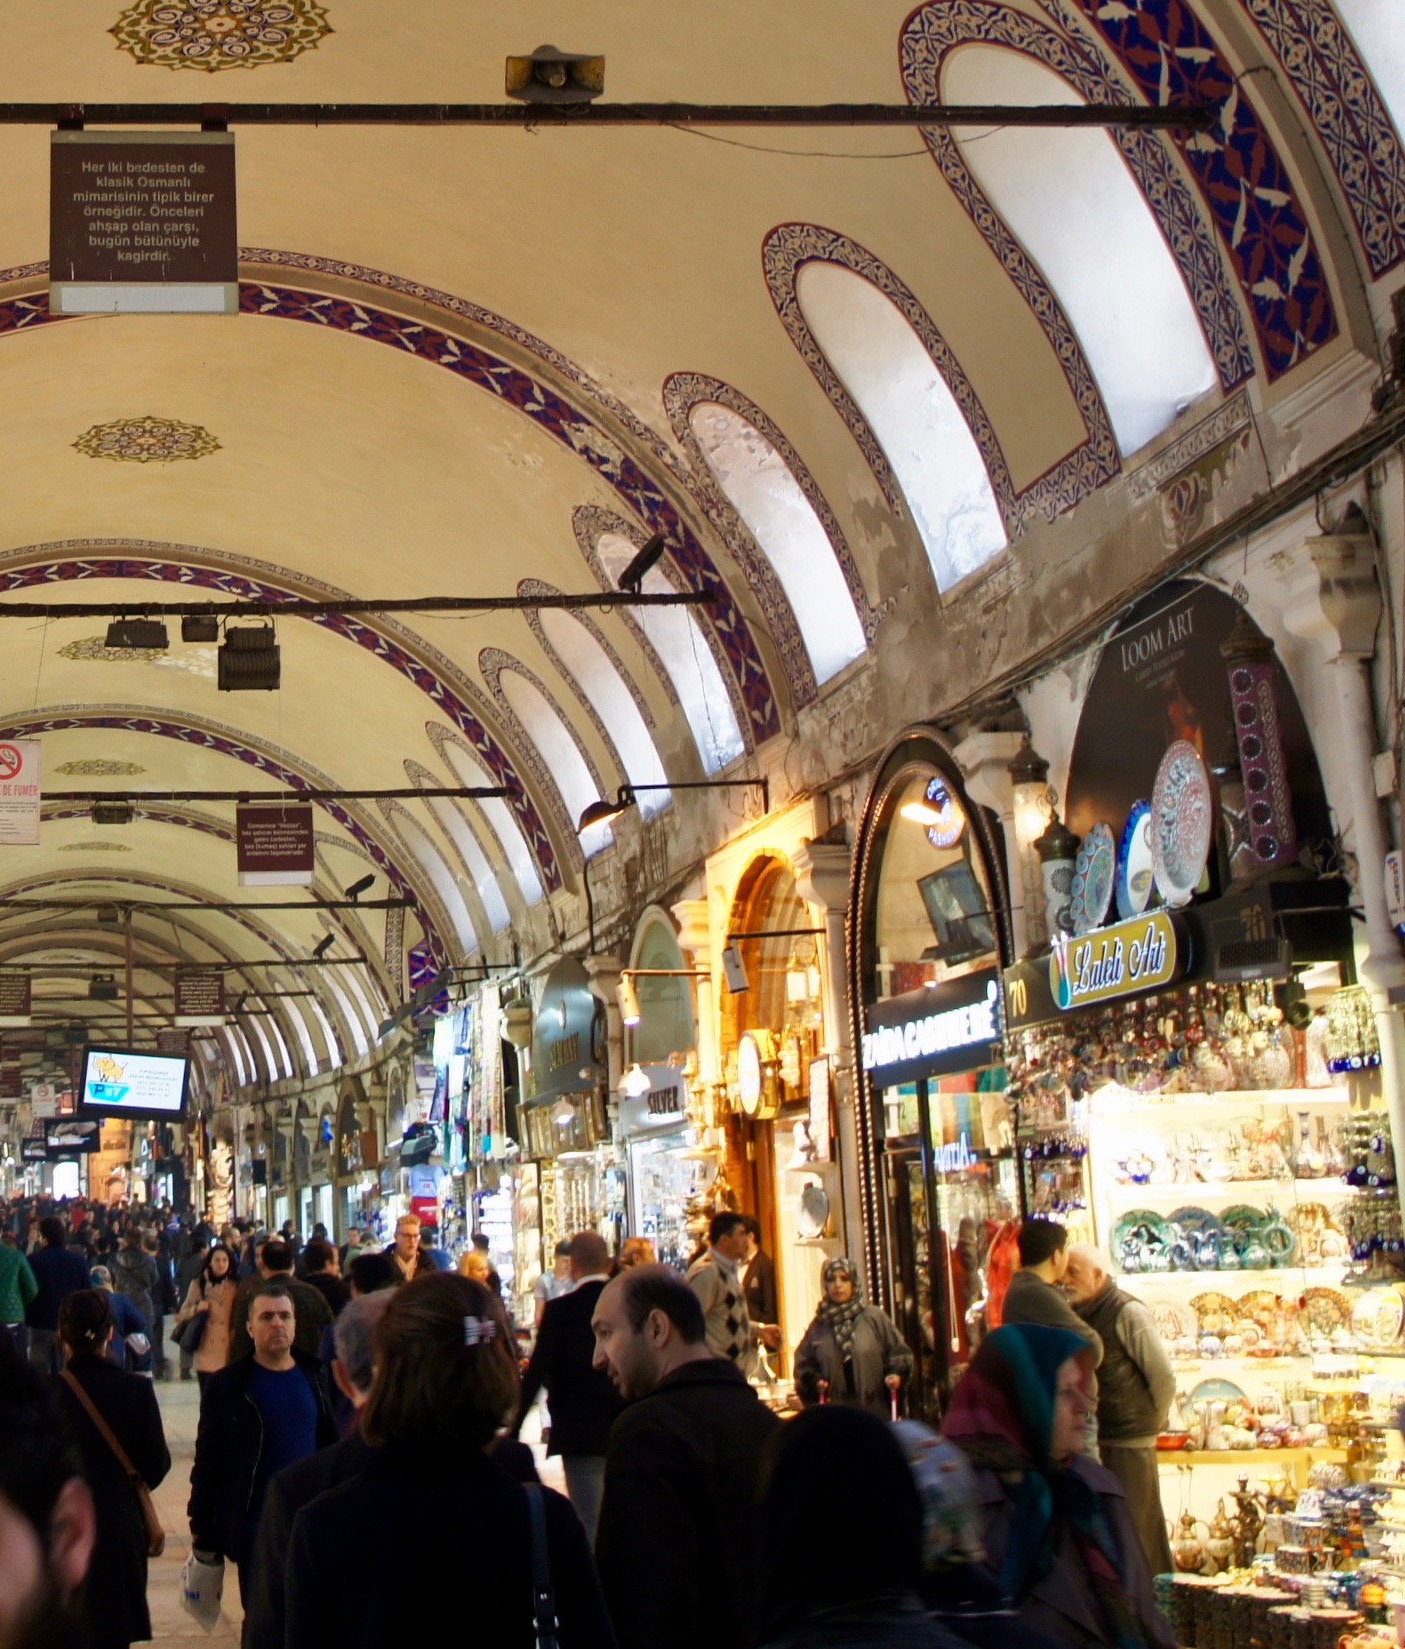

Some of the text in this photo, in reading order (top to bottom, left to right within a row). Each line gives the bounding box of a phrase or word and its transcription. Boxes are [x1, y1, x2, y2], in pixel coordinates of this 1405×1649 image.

[82, 161, 205, 174] Her iki bedesten de
[96, 176, 191, 188] klasik Osmanlı
[73, 191, 215, 204] mimarisinin tipik birer
[83, 204, 205, 220] örneğidir. Önceleri
[89, 221, 199, 235] ahşap olan çarşı,
[89, 234, 200, 250] bugün bütünüyle
[117, 250, 172, 263] kagirdir.
[1121, 628, 1163, 672] LOOM
[1167, 606, 1194, 646] ART
[3, 784, 11, 796] DE
[14, 785, 38, 796] FUMER
[1128, 921, 1166, 979] Art
[1009, 978, 1027, 1017] 70
